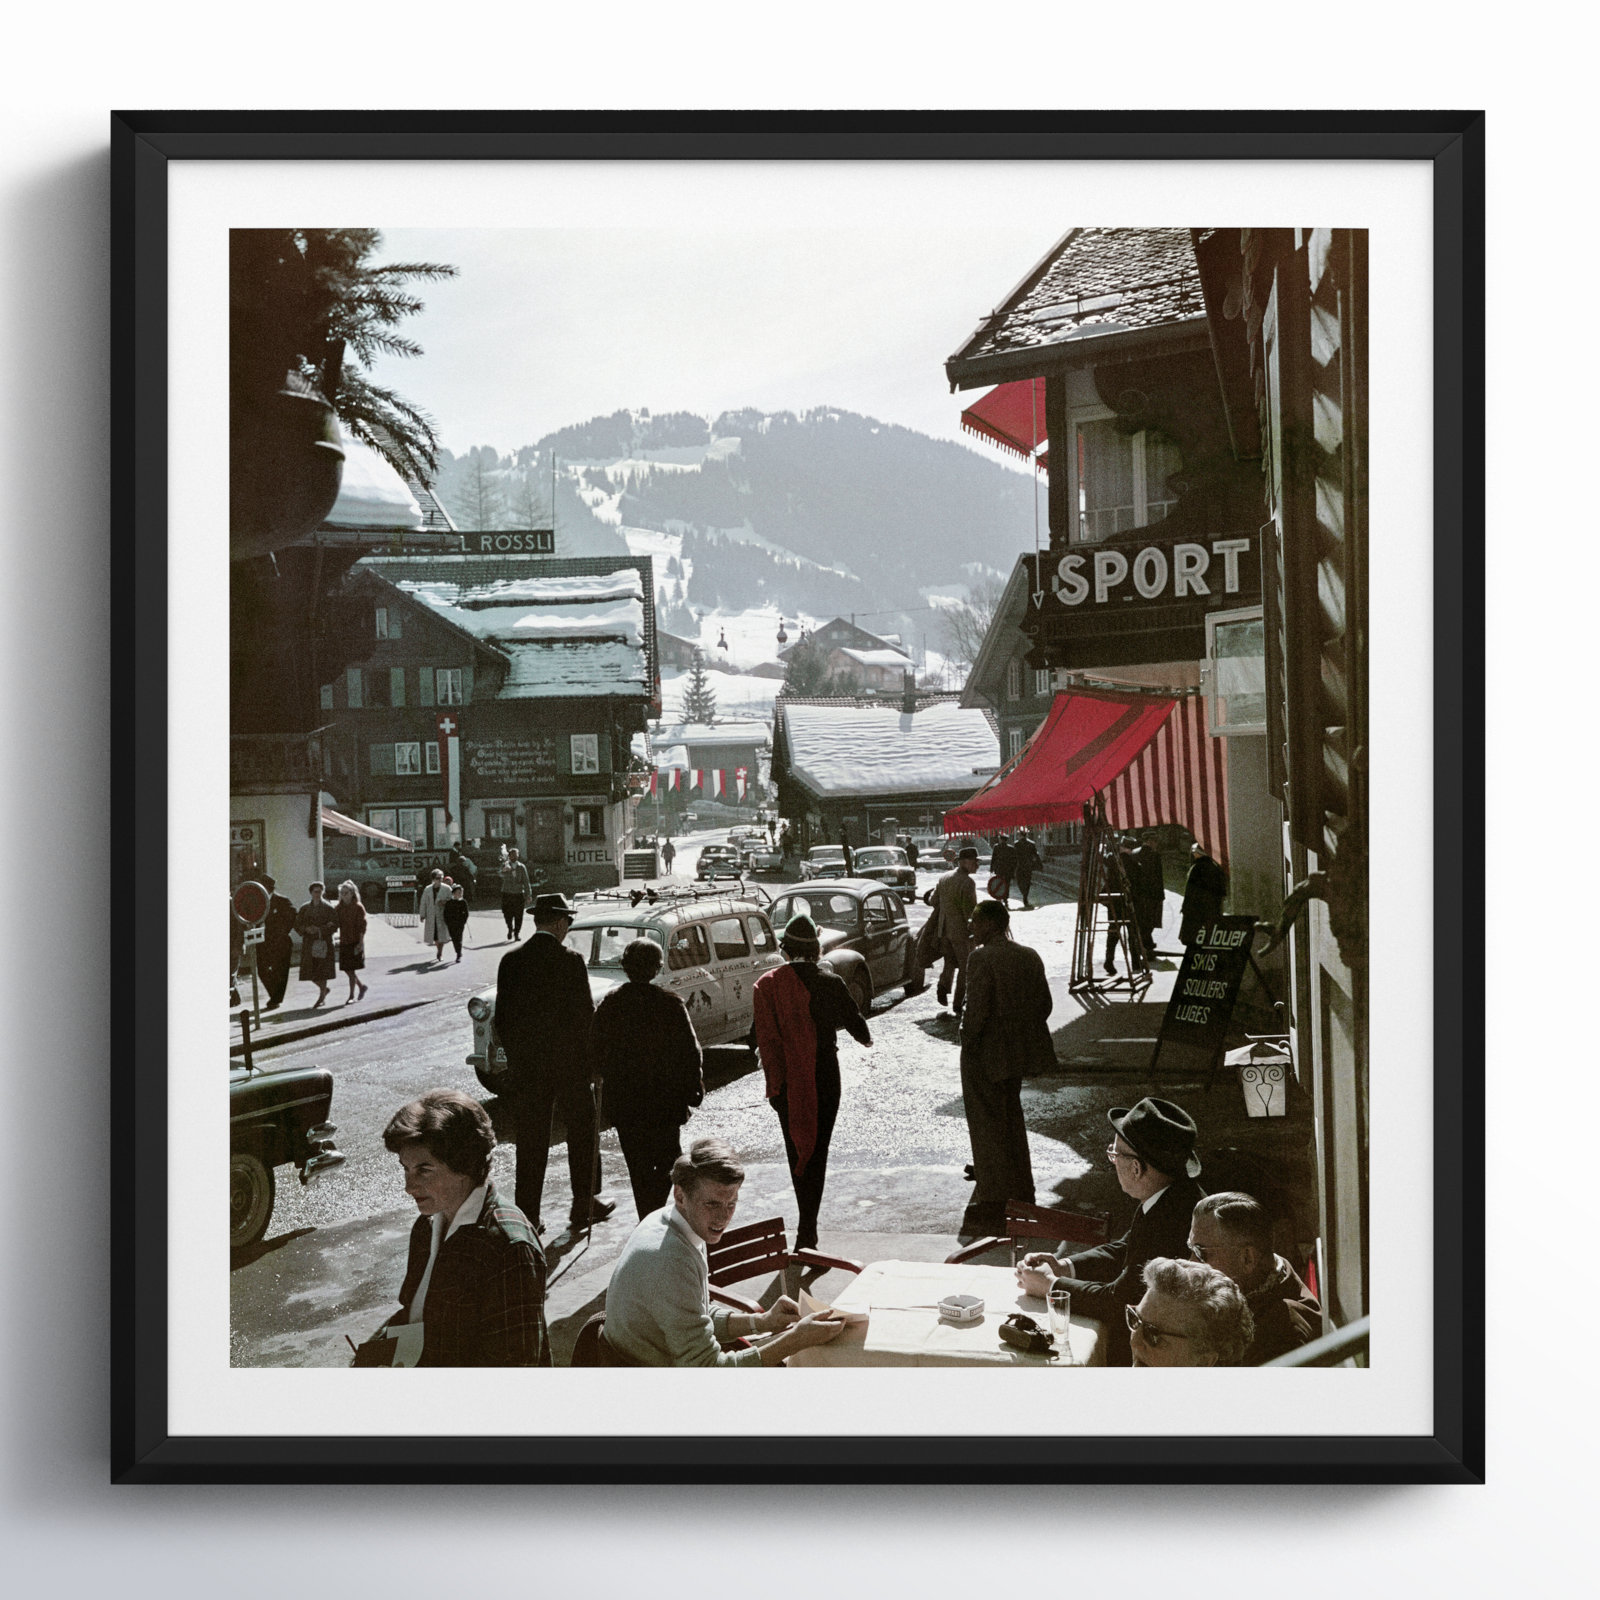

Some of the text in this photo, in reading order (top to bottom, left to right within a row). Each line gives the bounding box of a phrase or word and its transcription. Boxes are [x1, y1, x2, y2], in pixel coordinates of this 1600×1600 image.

[481, 534, 552, 551] RÖSSLI
[1056, 538, 1250, 606] SPORT
[567, 851, 613, 863] HOTEL
[1196, 924, 1247, 947] à louer
[1191, 953, 1218, 971] SKIS
[1183, 978, 1228, 999] SOULIERS
[1175, 1004, 1211, 1024] LUGES
